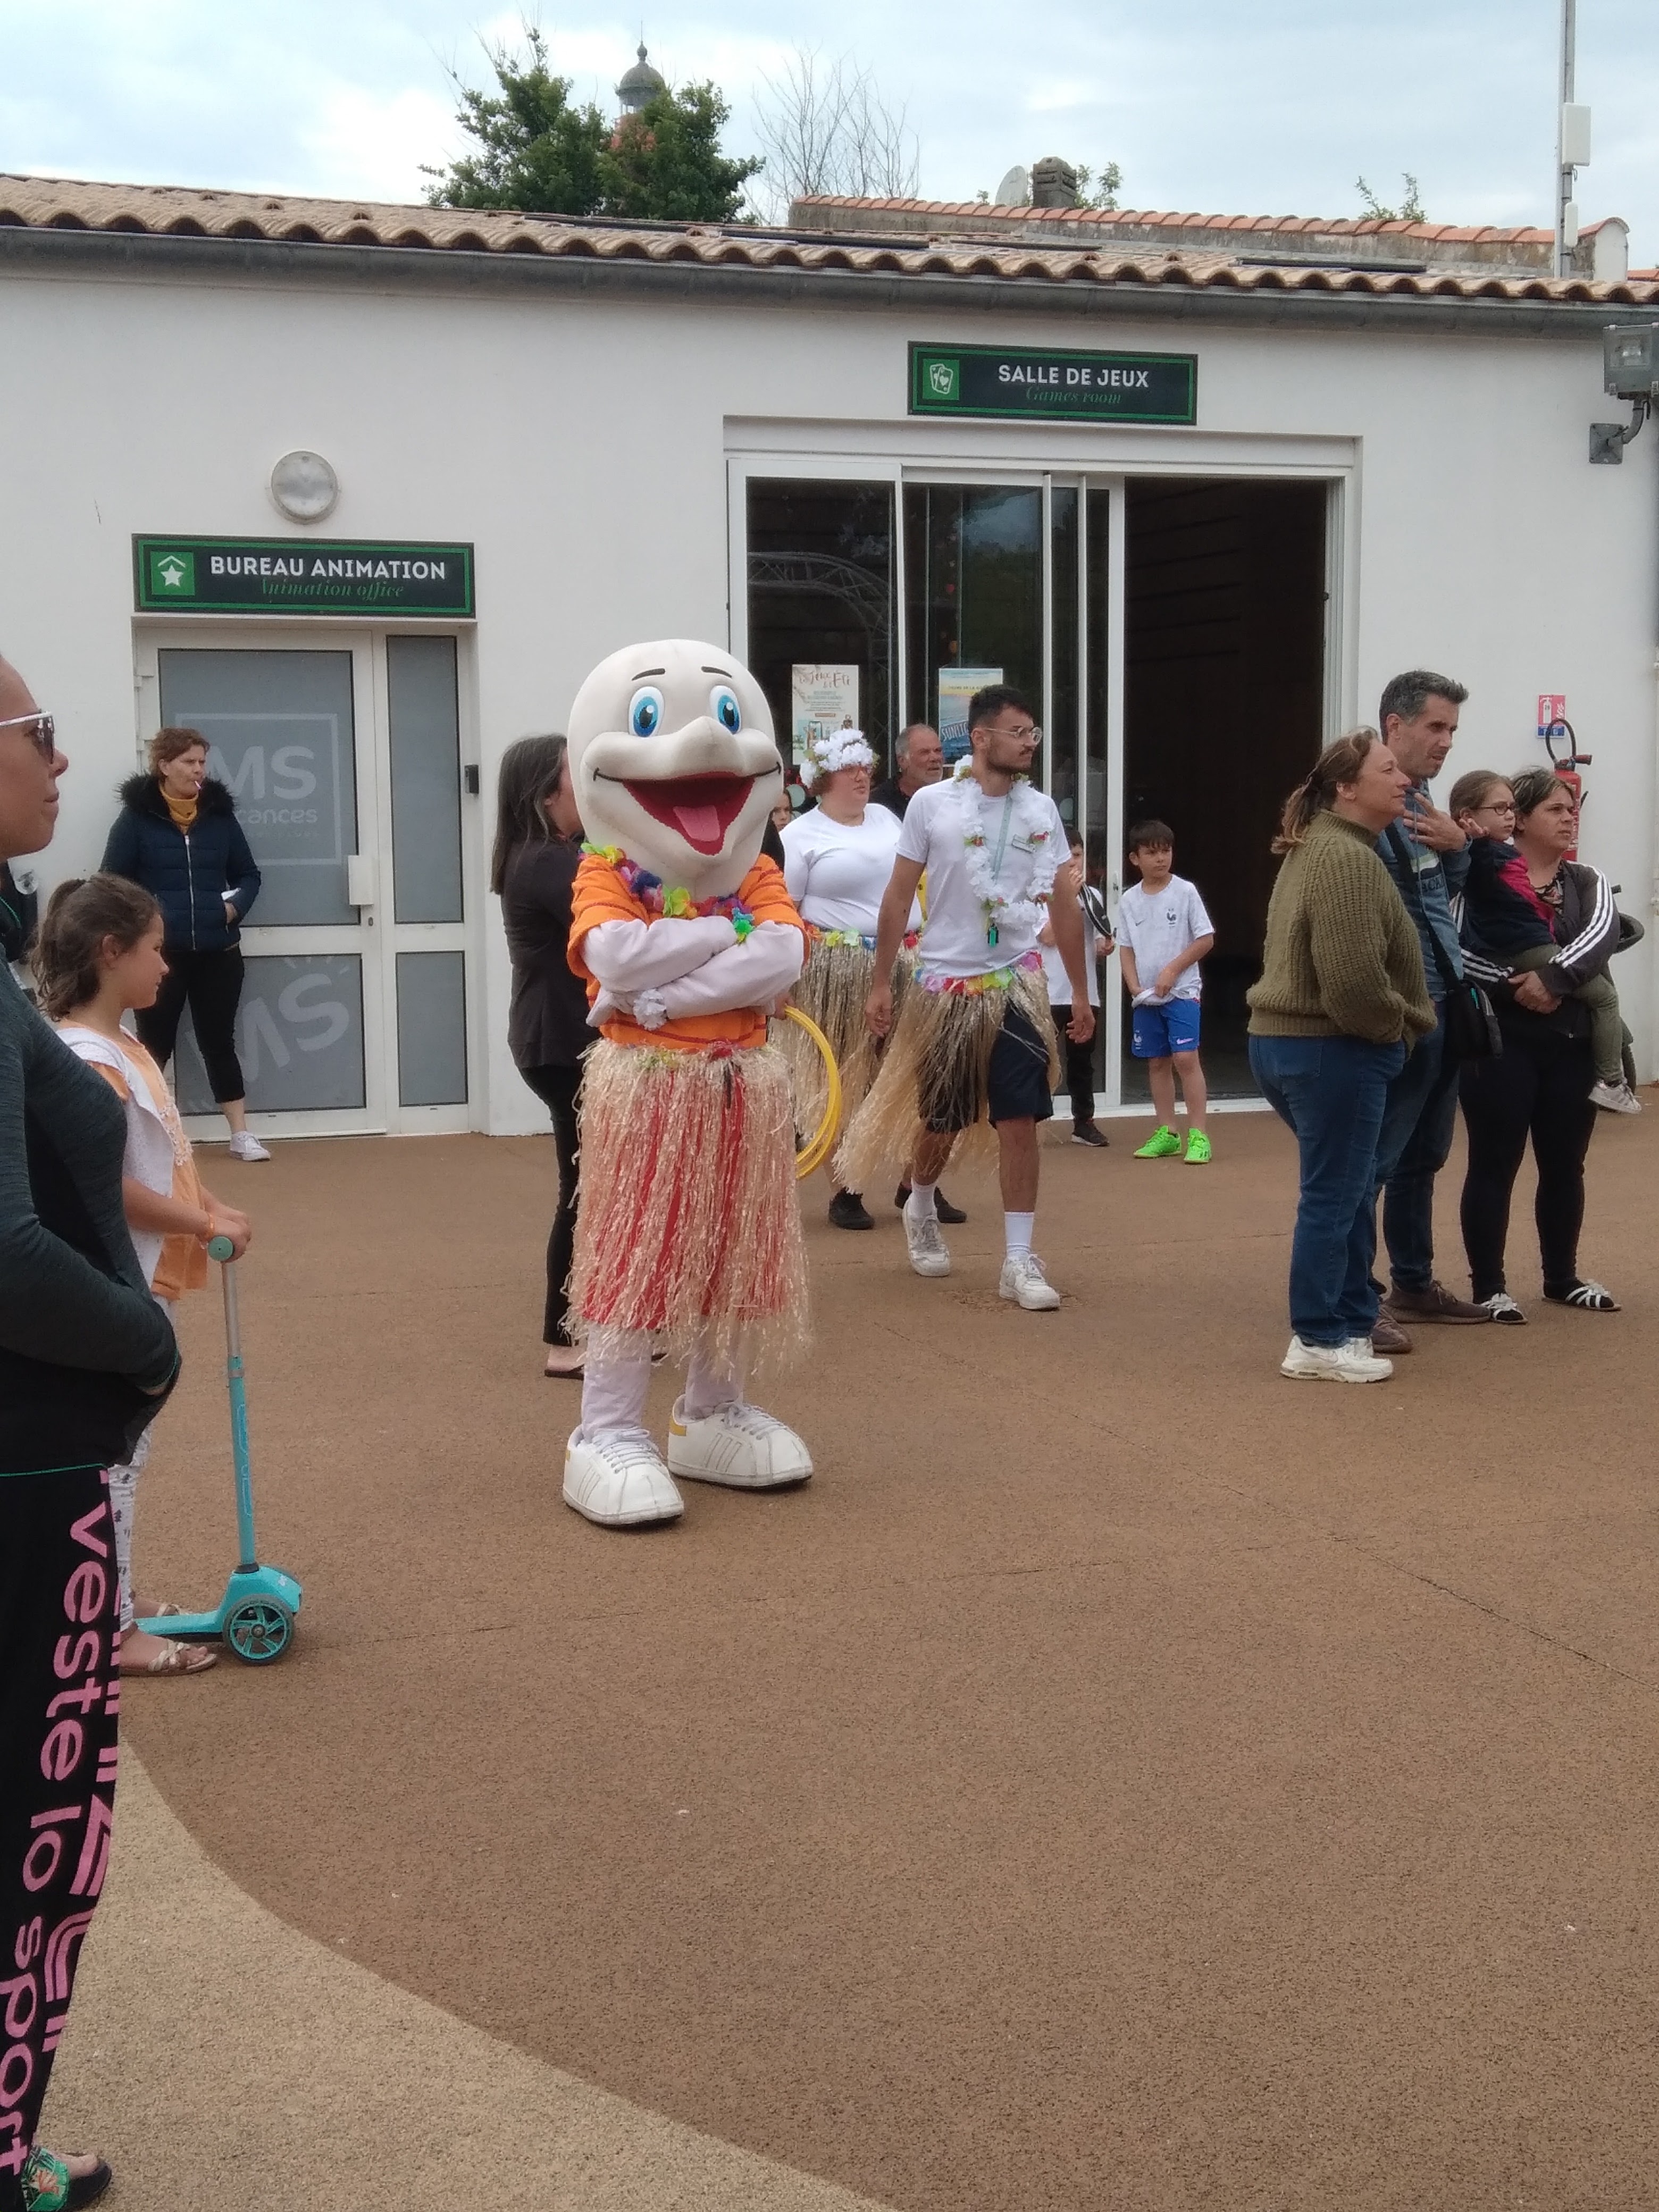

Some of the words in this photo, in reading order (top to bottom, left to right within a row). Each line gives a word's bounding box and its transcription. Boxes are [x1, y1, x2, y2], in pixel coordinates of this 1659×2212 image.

[999, 364, 1059, 384] SALLE
[1066, 367, 1092, 386] DE
[1096, 368, 1149, 388] JEUX
[1026, 386, 1078, 401] Games
[1083, 391, 1121, 405] room
[211, 556, 304, 576] BUREAU
[310, 558, 445, 580] ANIMATION
[357, 581, 404, 601] office
[205, 745, 317, 800] MS
[234, 809, 319, 824] cances
[0, 1915, 43, 2176] sport
